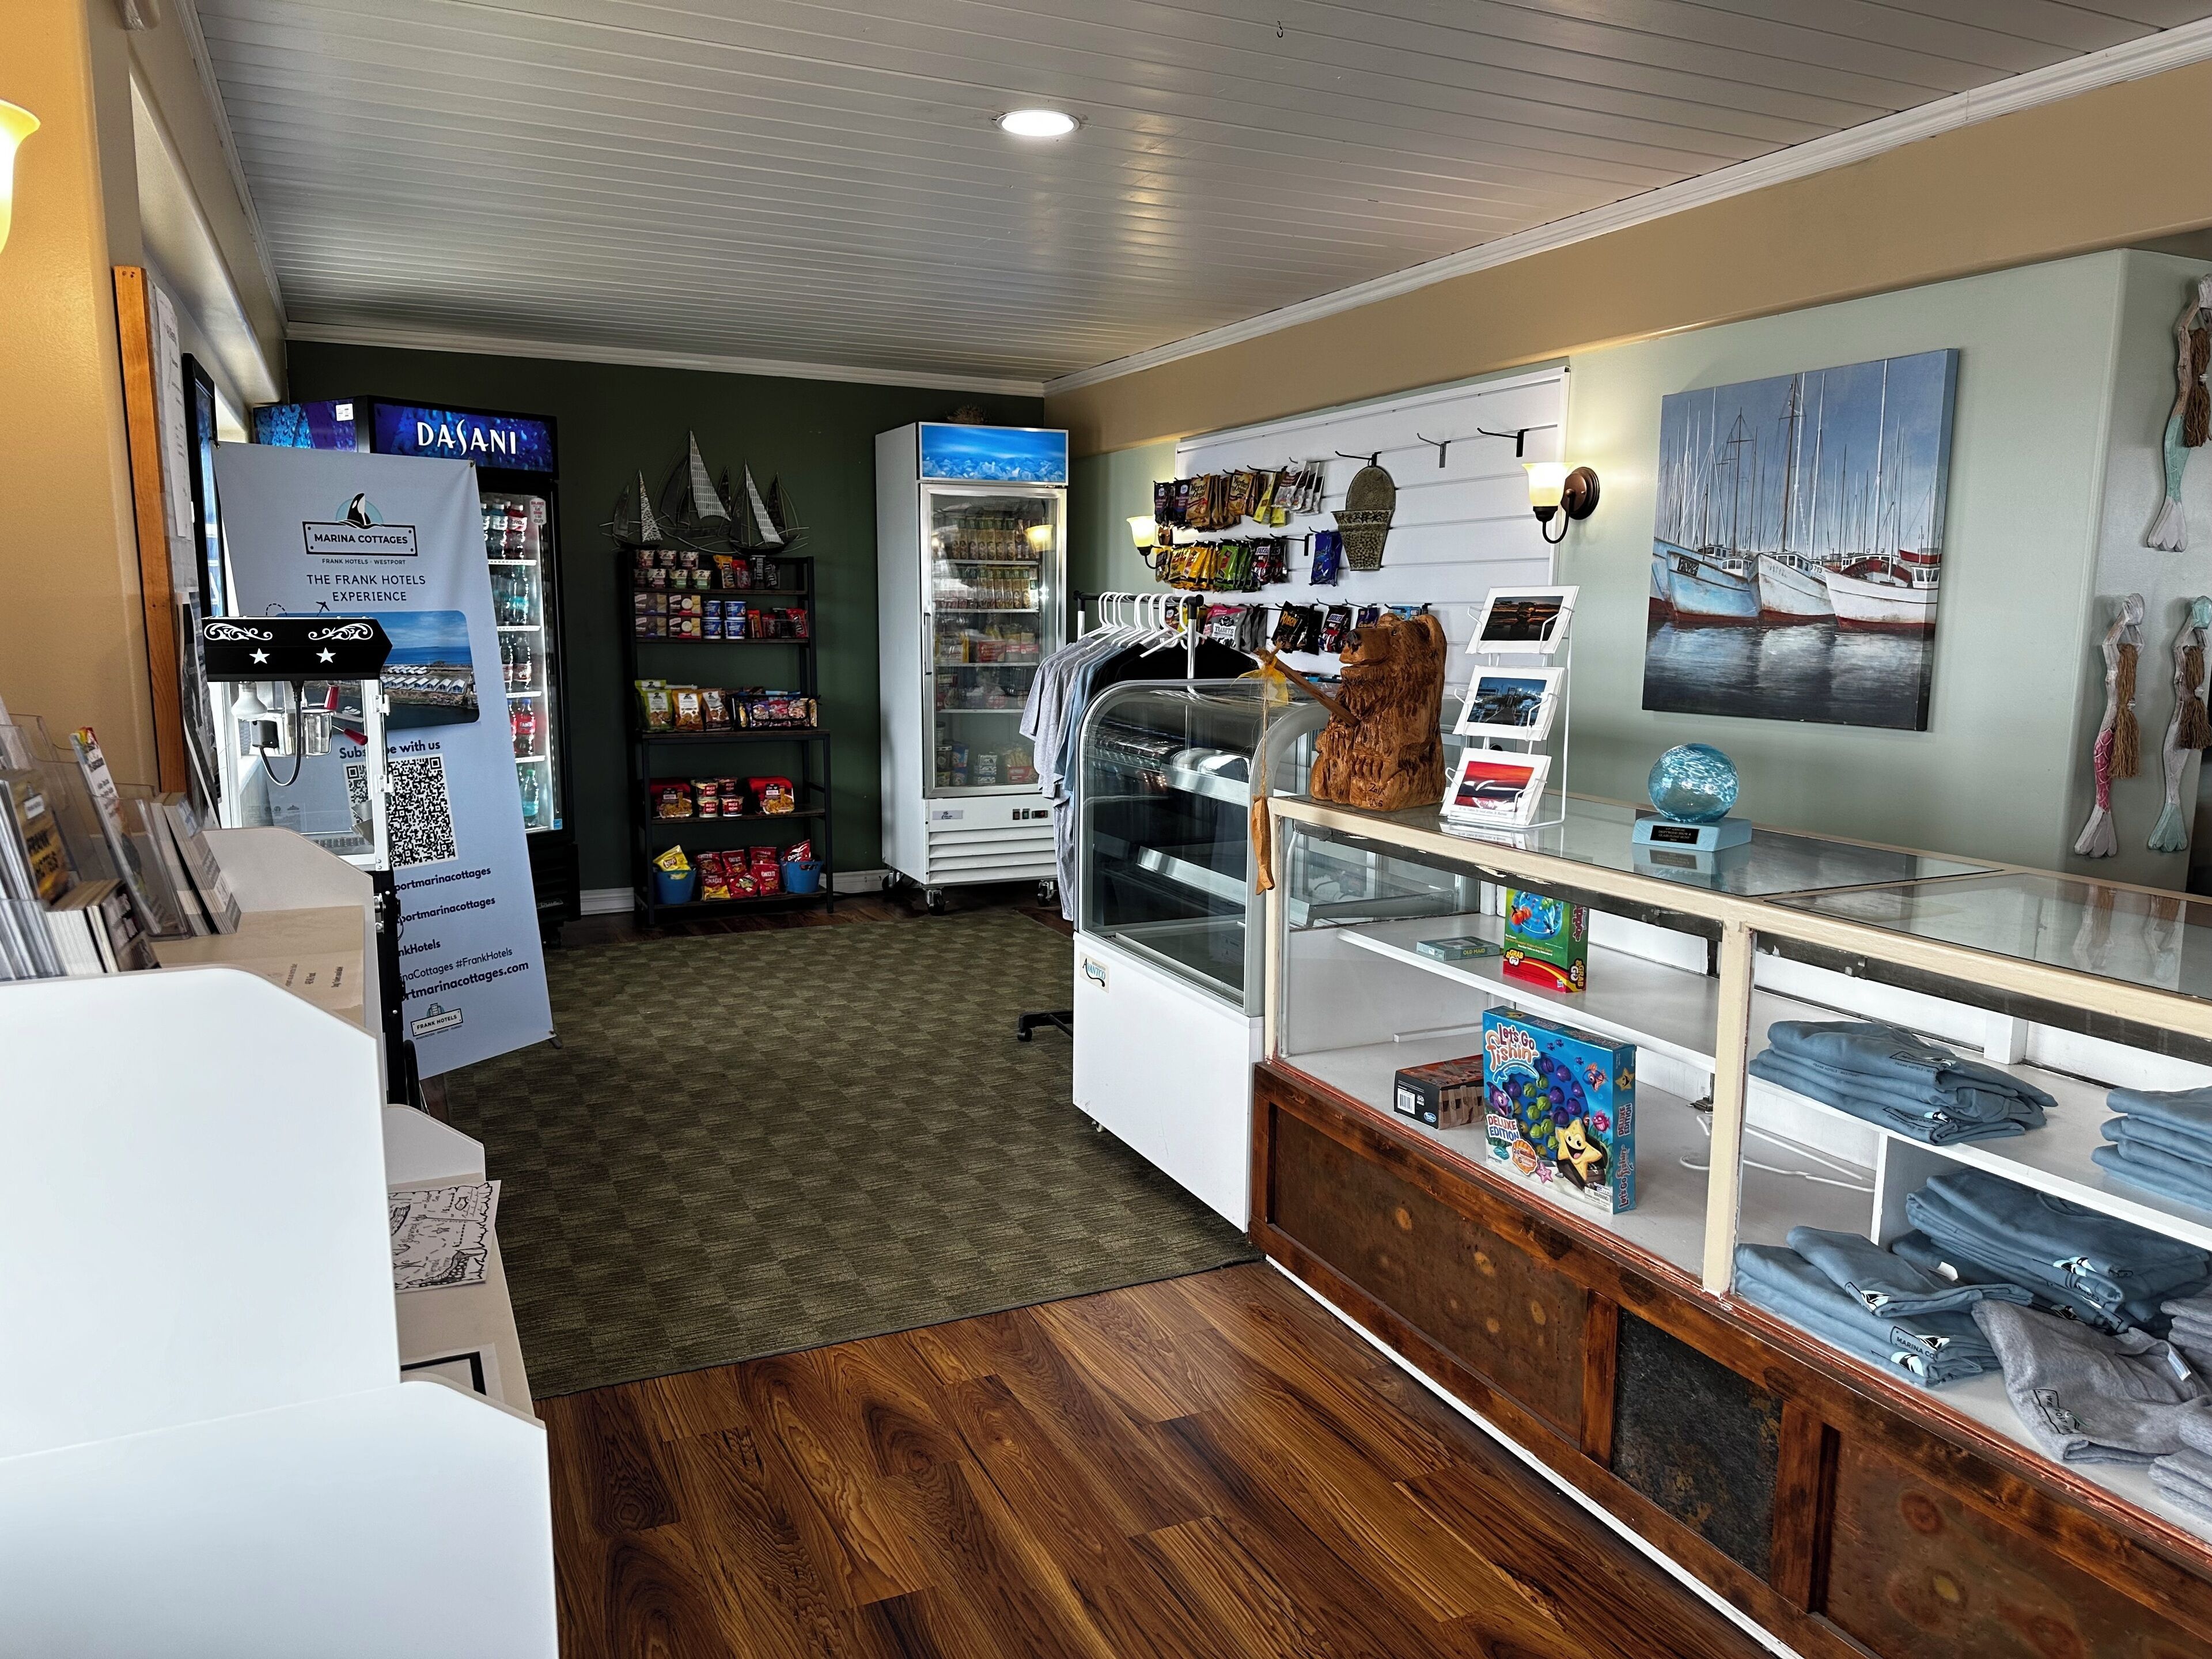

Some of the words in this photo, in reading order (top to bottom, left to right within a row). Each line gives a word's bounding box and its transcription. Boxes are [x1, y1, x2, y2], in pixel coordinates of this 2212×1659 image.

[417, 419, 516, 456] DASANI
[314, 533, 356, 543] MARINA
[358, 535, 408, 544] COTTAGES
[306, 574, 331, 585] THE
[335, 575, 377, 585] FRANK
[381, 575, 426, 585] HOTELS
[332, 592, 407, 601] EXPERIENCE
[399, 740, 426, 752] with
[428, 741, 441, 749] us
[395, 868, 491, 892] portmarinacottages
[397, 897, 495, 926] portmarinacottages
[399, 939, 441, 957] nkHotels
[1509, 949, 1524, 959] GRAB
[400, 963, 453, 982] inaCottages
[456, 948, 513, 968] #FrankHotels
[1082, 957, 1106, 981] AVANTCO
[416, 1020, 435, 1030] FRANK
[437, 1014, 457, 1024] HOTELS
[1498, 1024, 1519, 1046] Let's
[1521, 1032, 1535, 1051] Go
[1488, 1115, 1517, 1130] DELUXE
[1490, 1126, 1519, 1141] EDITION
[1620, 1177, 1627, 1190] Go
[1897, 1336, 1923, 1354] MARINA
